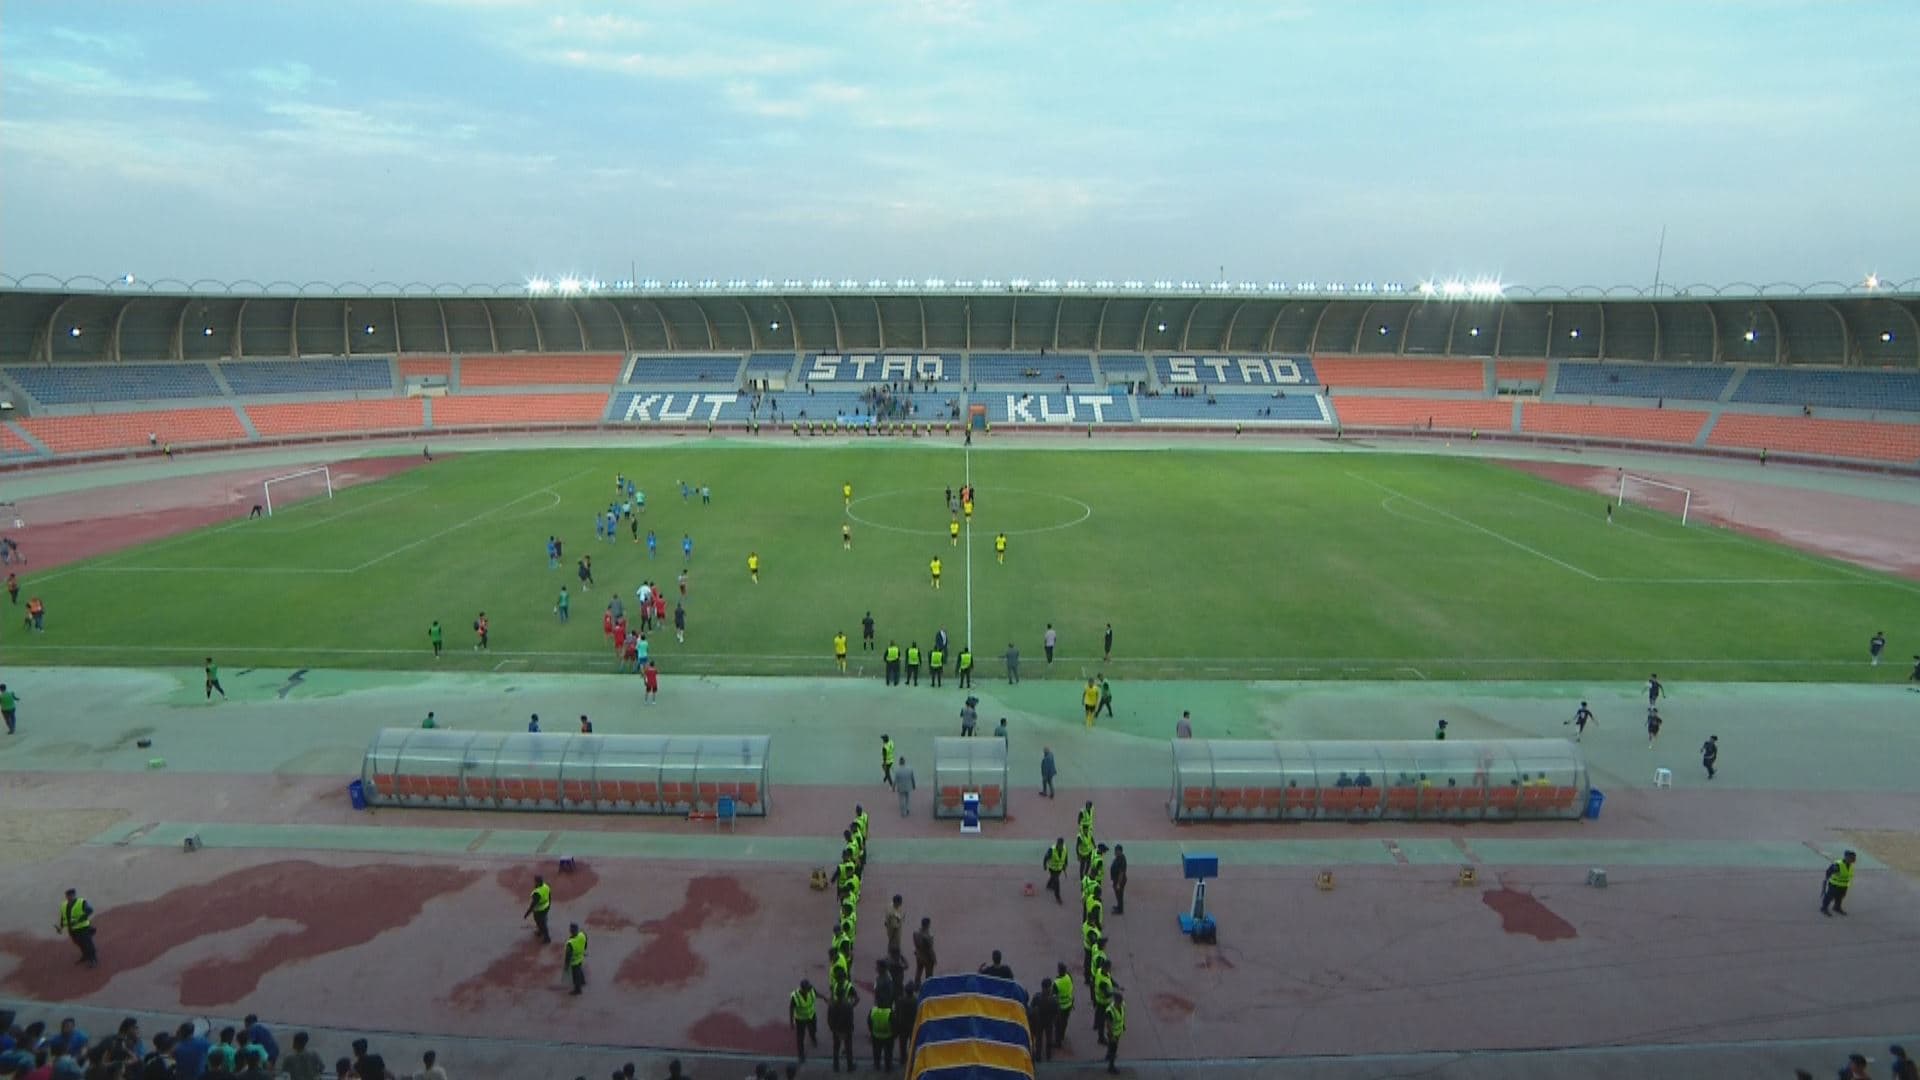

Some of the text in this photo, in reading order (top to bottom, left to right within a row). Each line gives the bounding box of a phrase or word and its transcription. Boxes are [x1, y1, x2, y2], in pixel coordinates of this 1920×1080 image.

[1169, 357, 1310, 382] STAD.
[624, 394, 737, 421] KUT
[1007, 394, 1113, 422] KUT
